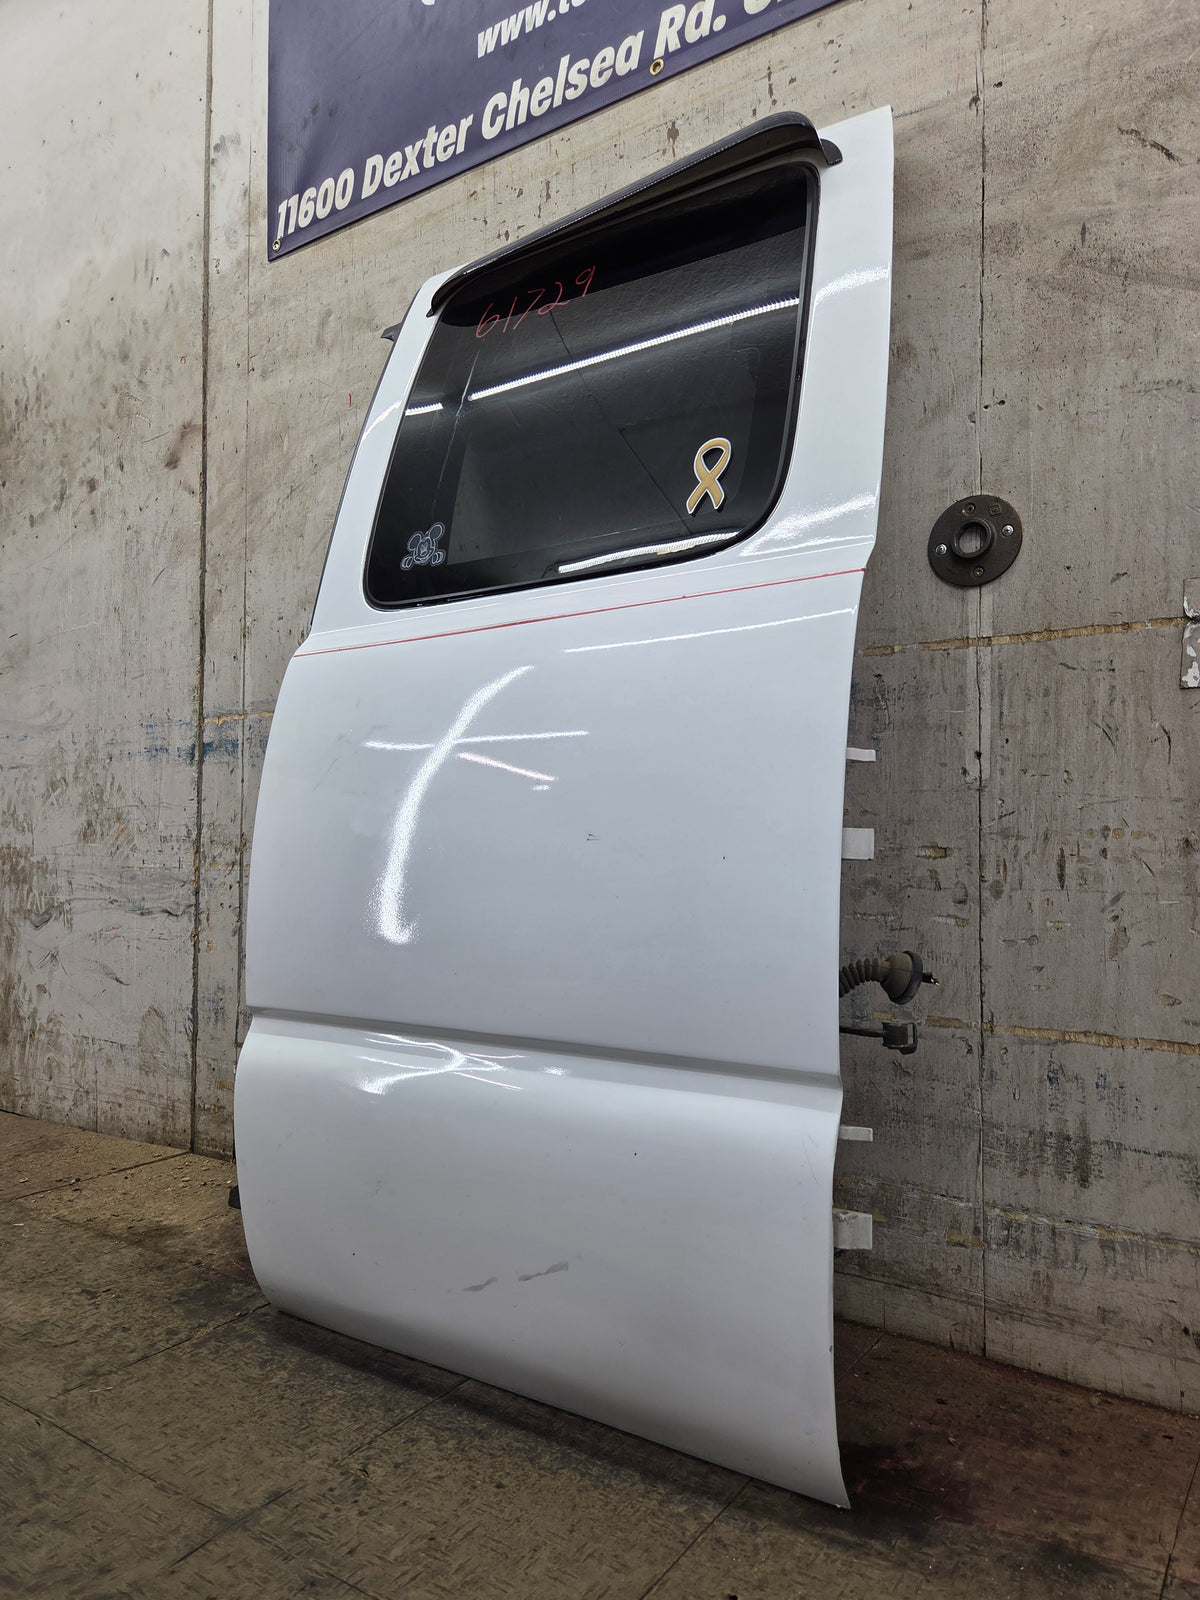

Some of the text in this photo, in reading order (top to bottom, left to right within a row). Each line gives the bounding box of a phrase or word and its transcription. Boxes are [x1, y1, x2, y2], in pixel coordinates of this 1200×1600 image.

[477, 0, 587, 59] www.
[277, 0, 727, 240] 11600 Dexter Chelsea Rd.
[475, 265, 596, 339] 61729
